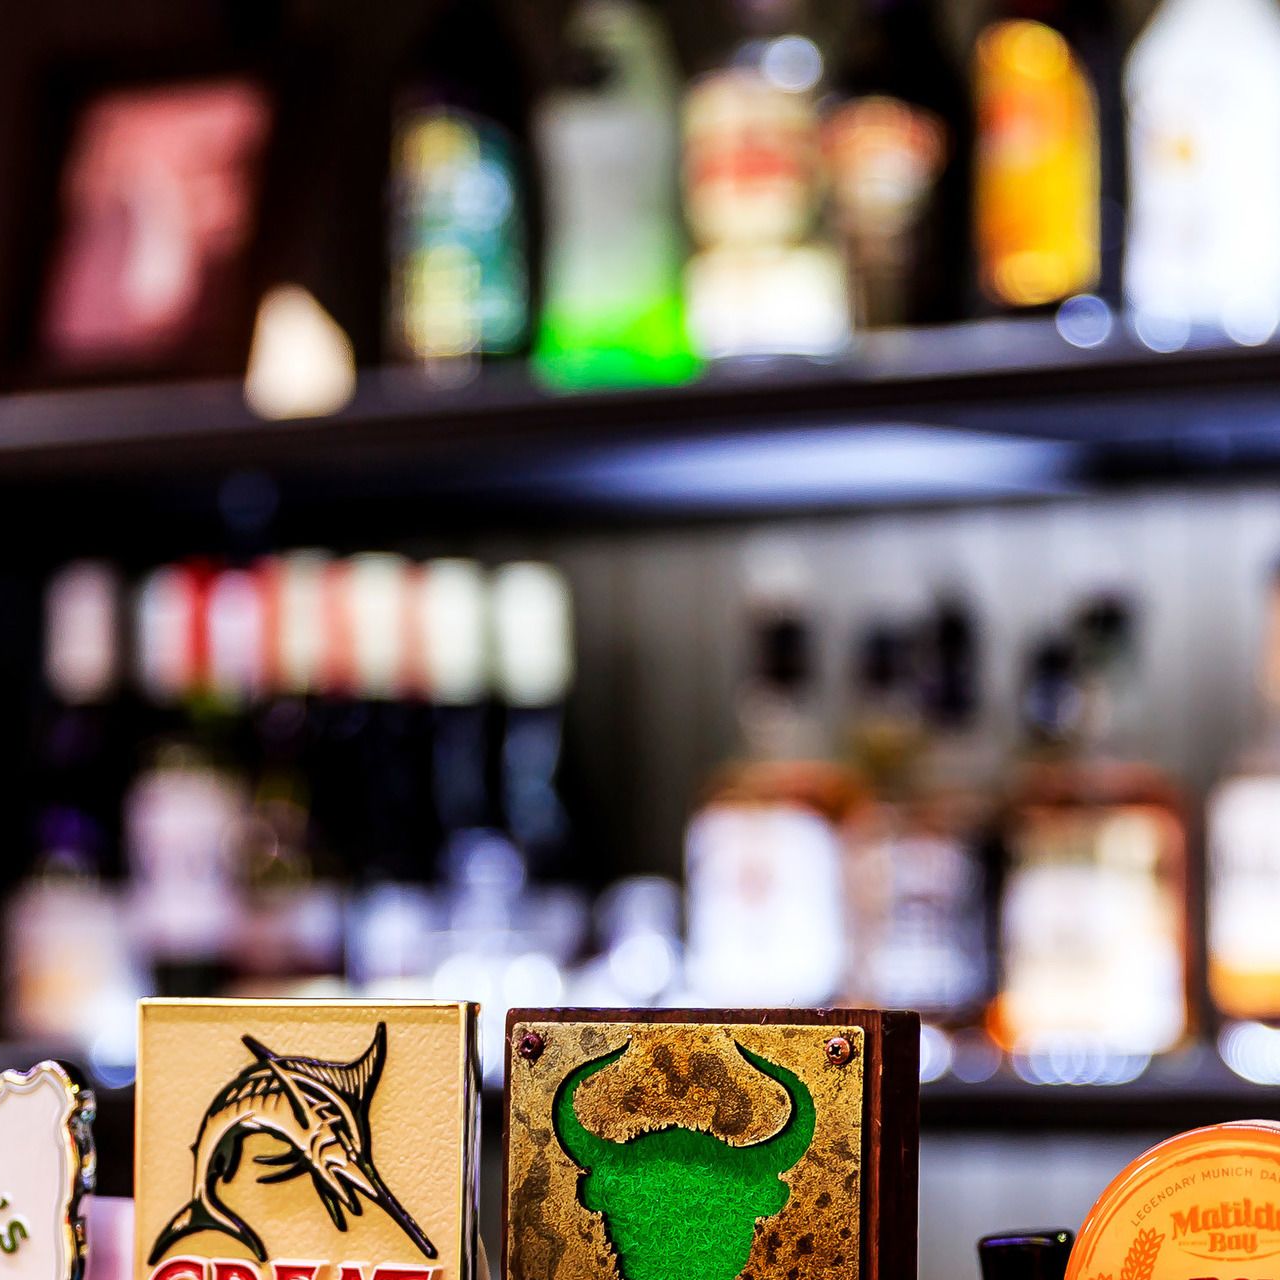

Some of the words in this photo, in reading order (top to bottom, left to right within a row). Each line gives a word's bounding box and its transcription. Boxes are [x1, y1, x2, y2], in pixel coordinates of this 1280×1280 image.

[1131, 1175, 1197, 1228] LEGENDARY
[1201, 1167, 1253, 1181] MUNICH
[1208, 1231, 1259, 1254] Bay
